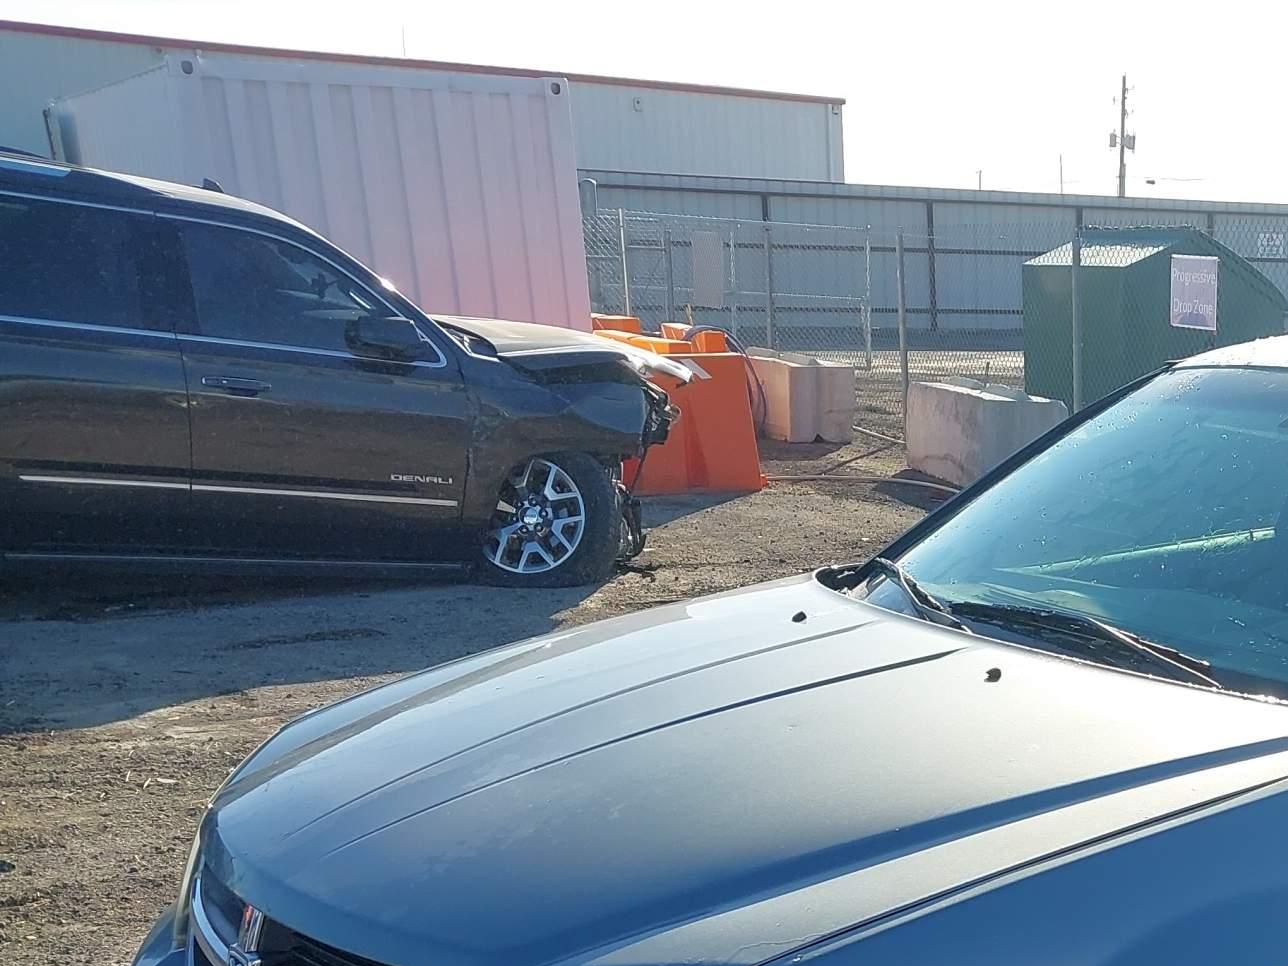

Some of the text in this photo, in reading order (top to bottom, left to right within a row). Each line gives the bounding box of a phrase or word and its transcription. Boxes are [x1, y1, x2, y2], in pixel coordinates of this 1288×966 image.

[1172, 268, 1216, 286] Progressive
[1173, 298, 1213, 317] Drop Zone
[390, 473, 453, 485] DENALI
